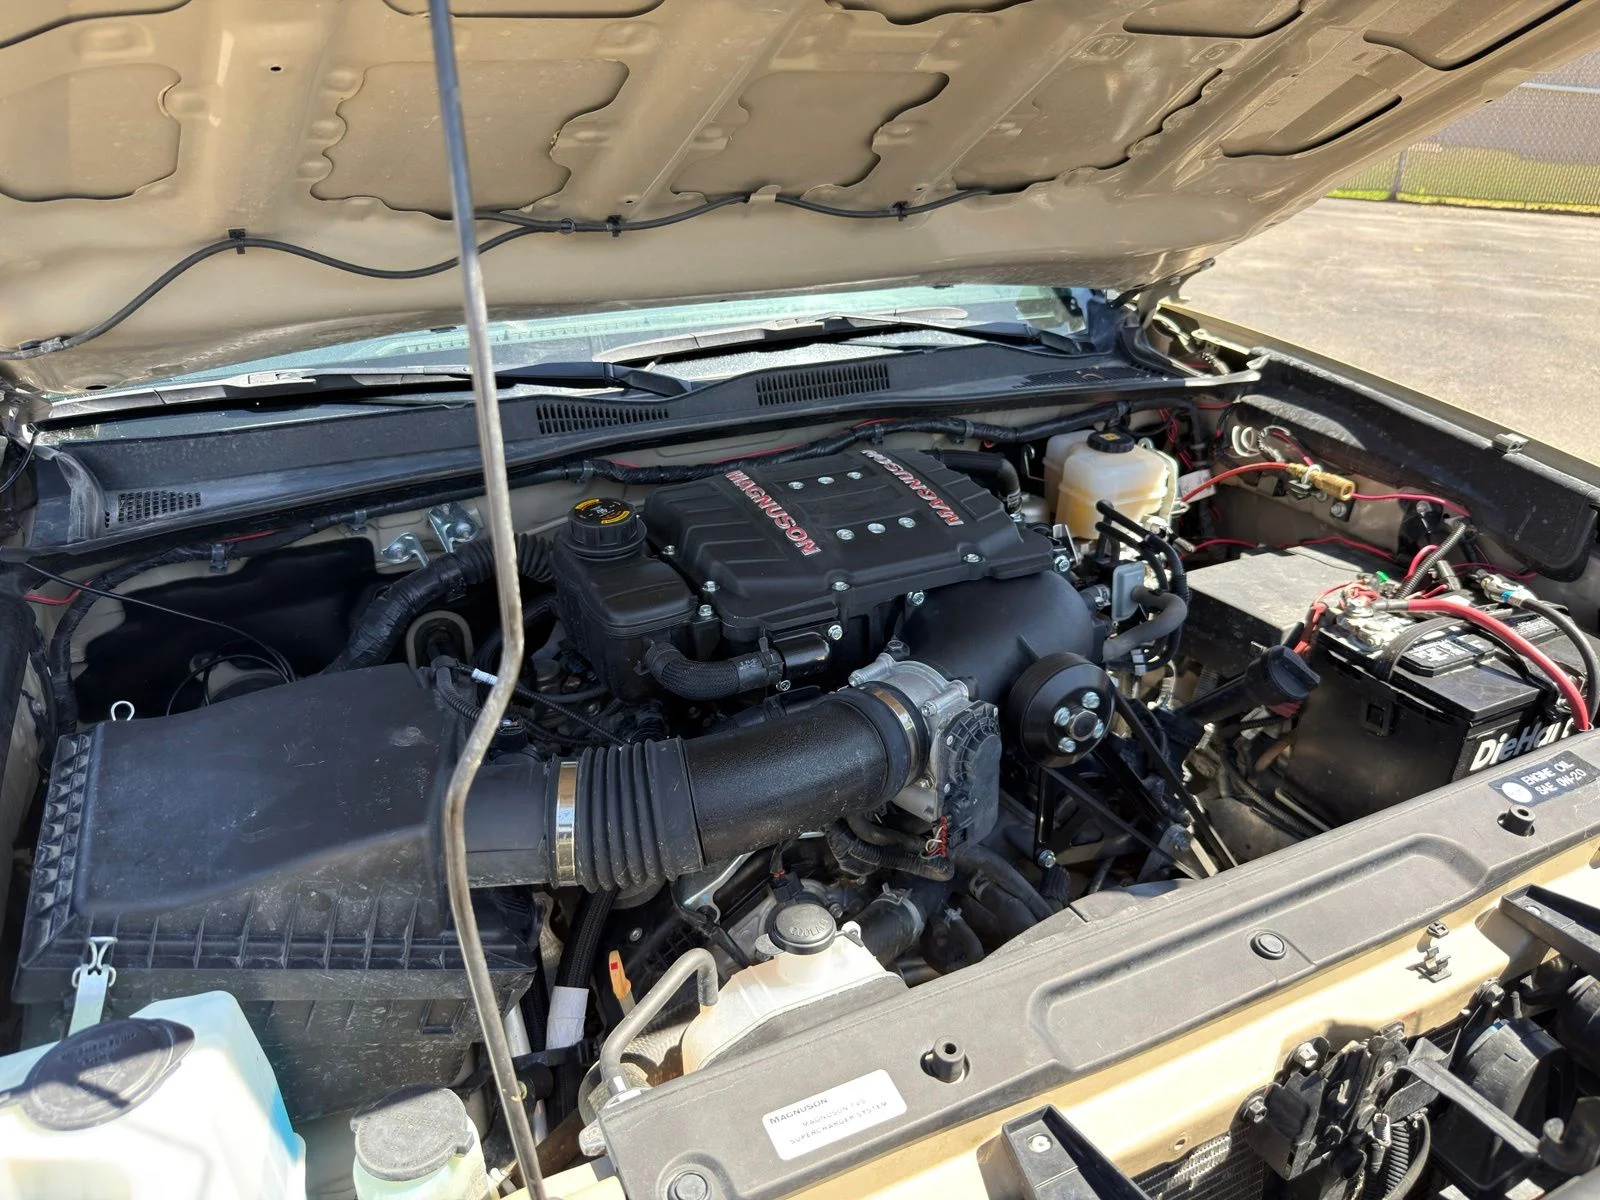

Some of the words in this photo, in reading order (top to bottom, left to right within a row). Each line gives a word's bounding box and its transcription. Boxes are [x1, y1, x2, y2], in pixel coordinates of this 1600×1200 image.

[862, 450, 964, 525] MAGNUSON
[726, 470, 822, 556] MAGNUSON
[1521, 767, 1556, 785] ENGINE
[1554, 760, 1575, 772] OIL
[1535, 782, 1558, 795] SAE
[1556, 768, 1587, 787] 0W-20
[769, 1098, 828, 1125] MAGNUSON
[790, 1115, 854, 1144] SUPERCHARGER
[856, 1101, 888, 1117] SYSTEM
[803, 1106, 848, 1126] MAGNUSON
